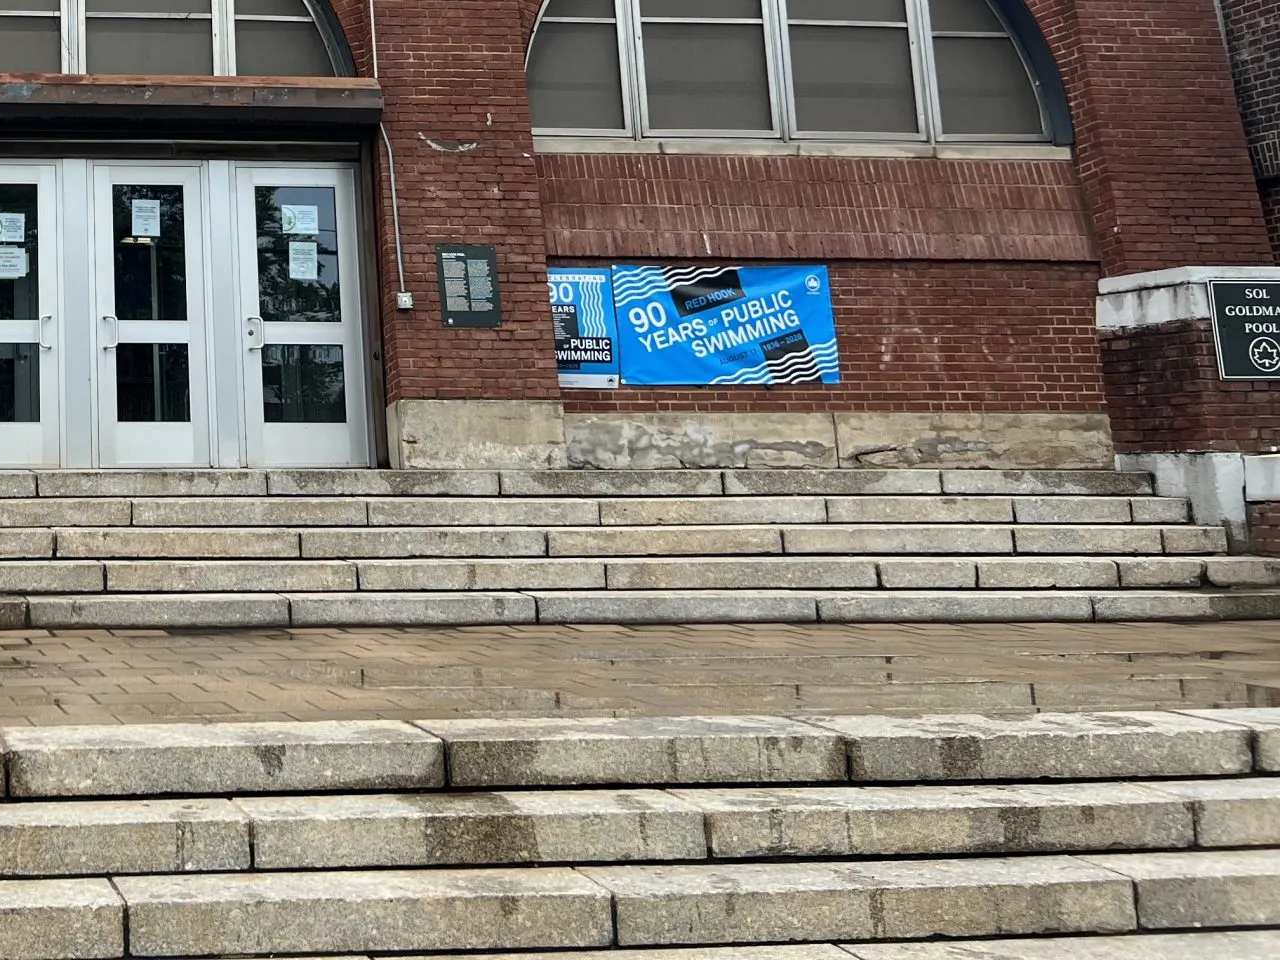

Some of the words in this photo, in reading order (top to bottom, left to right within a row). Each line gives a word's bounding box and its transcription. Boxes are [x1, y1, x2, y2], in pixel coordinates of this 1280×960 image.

[684, 296, 706, 310] RED
[708, 288, 736, 303] HOOK
[1245, 288, 1270, 299] SOL
[552, 305, 575, 313] EARS
[1225, 305, 1280, 316] GOLDMA
[628, 301, 667, 333] 90
[638, 318, 707, 353] YEARS
[708, 318, 718, 327] OF
[720, 290, 792, 327] PUBLIC
[691, 309, 800, 358] SWIMMING
[1245, 322, 1280, 333] POOL
[571, 339, 610, 349] PUBLIC
[786, 333, 803, 345] 2026
[720, 351, 748, 365] AUGUST
